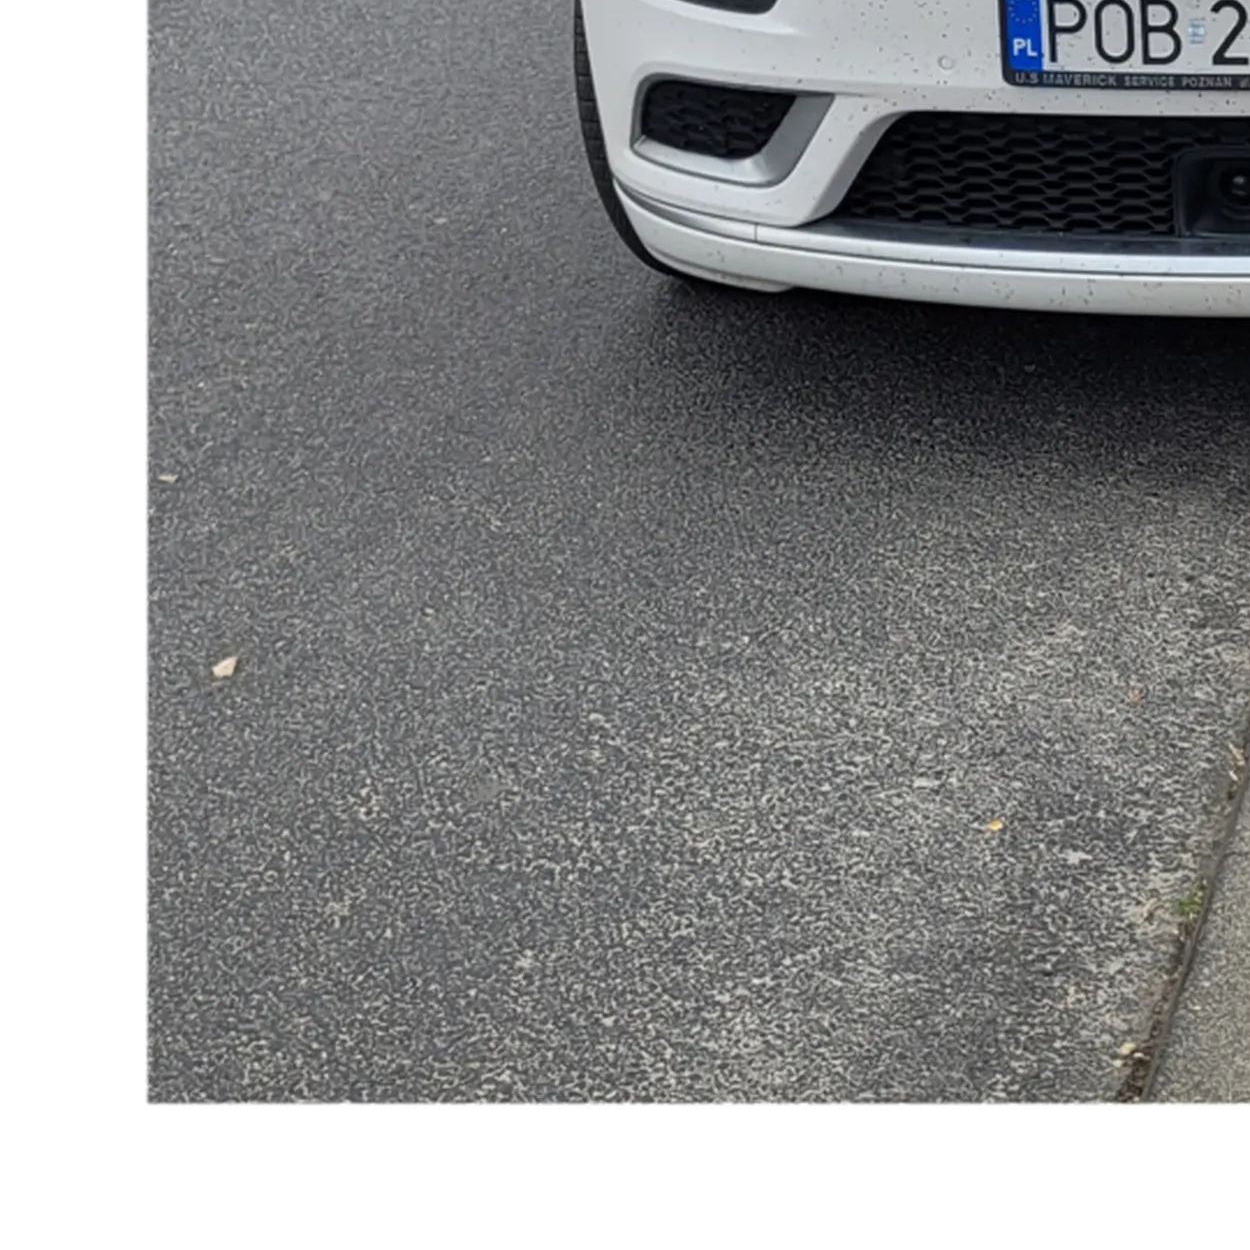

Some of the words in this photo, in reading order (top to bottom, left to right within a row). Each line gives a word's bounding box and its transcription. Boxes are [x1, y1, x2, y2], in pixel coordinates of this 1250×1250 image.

[1013, 38, 1038, 57] PL
[1042, 72, 1118, 87] MAVERICK
[1124, 74, 1175, 88] SERVICE
